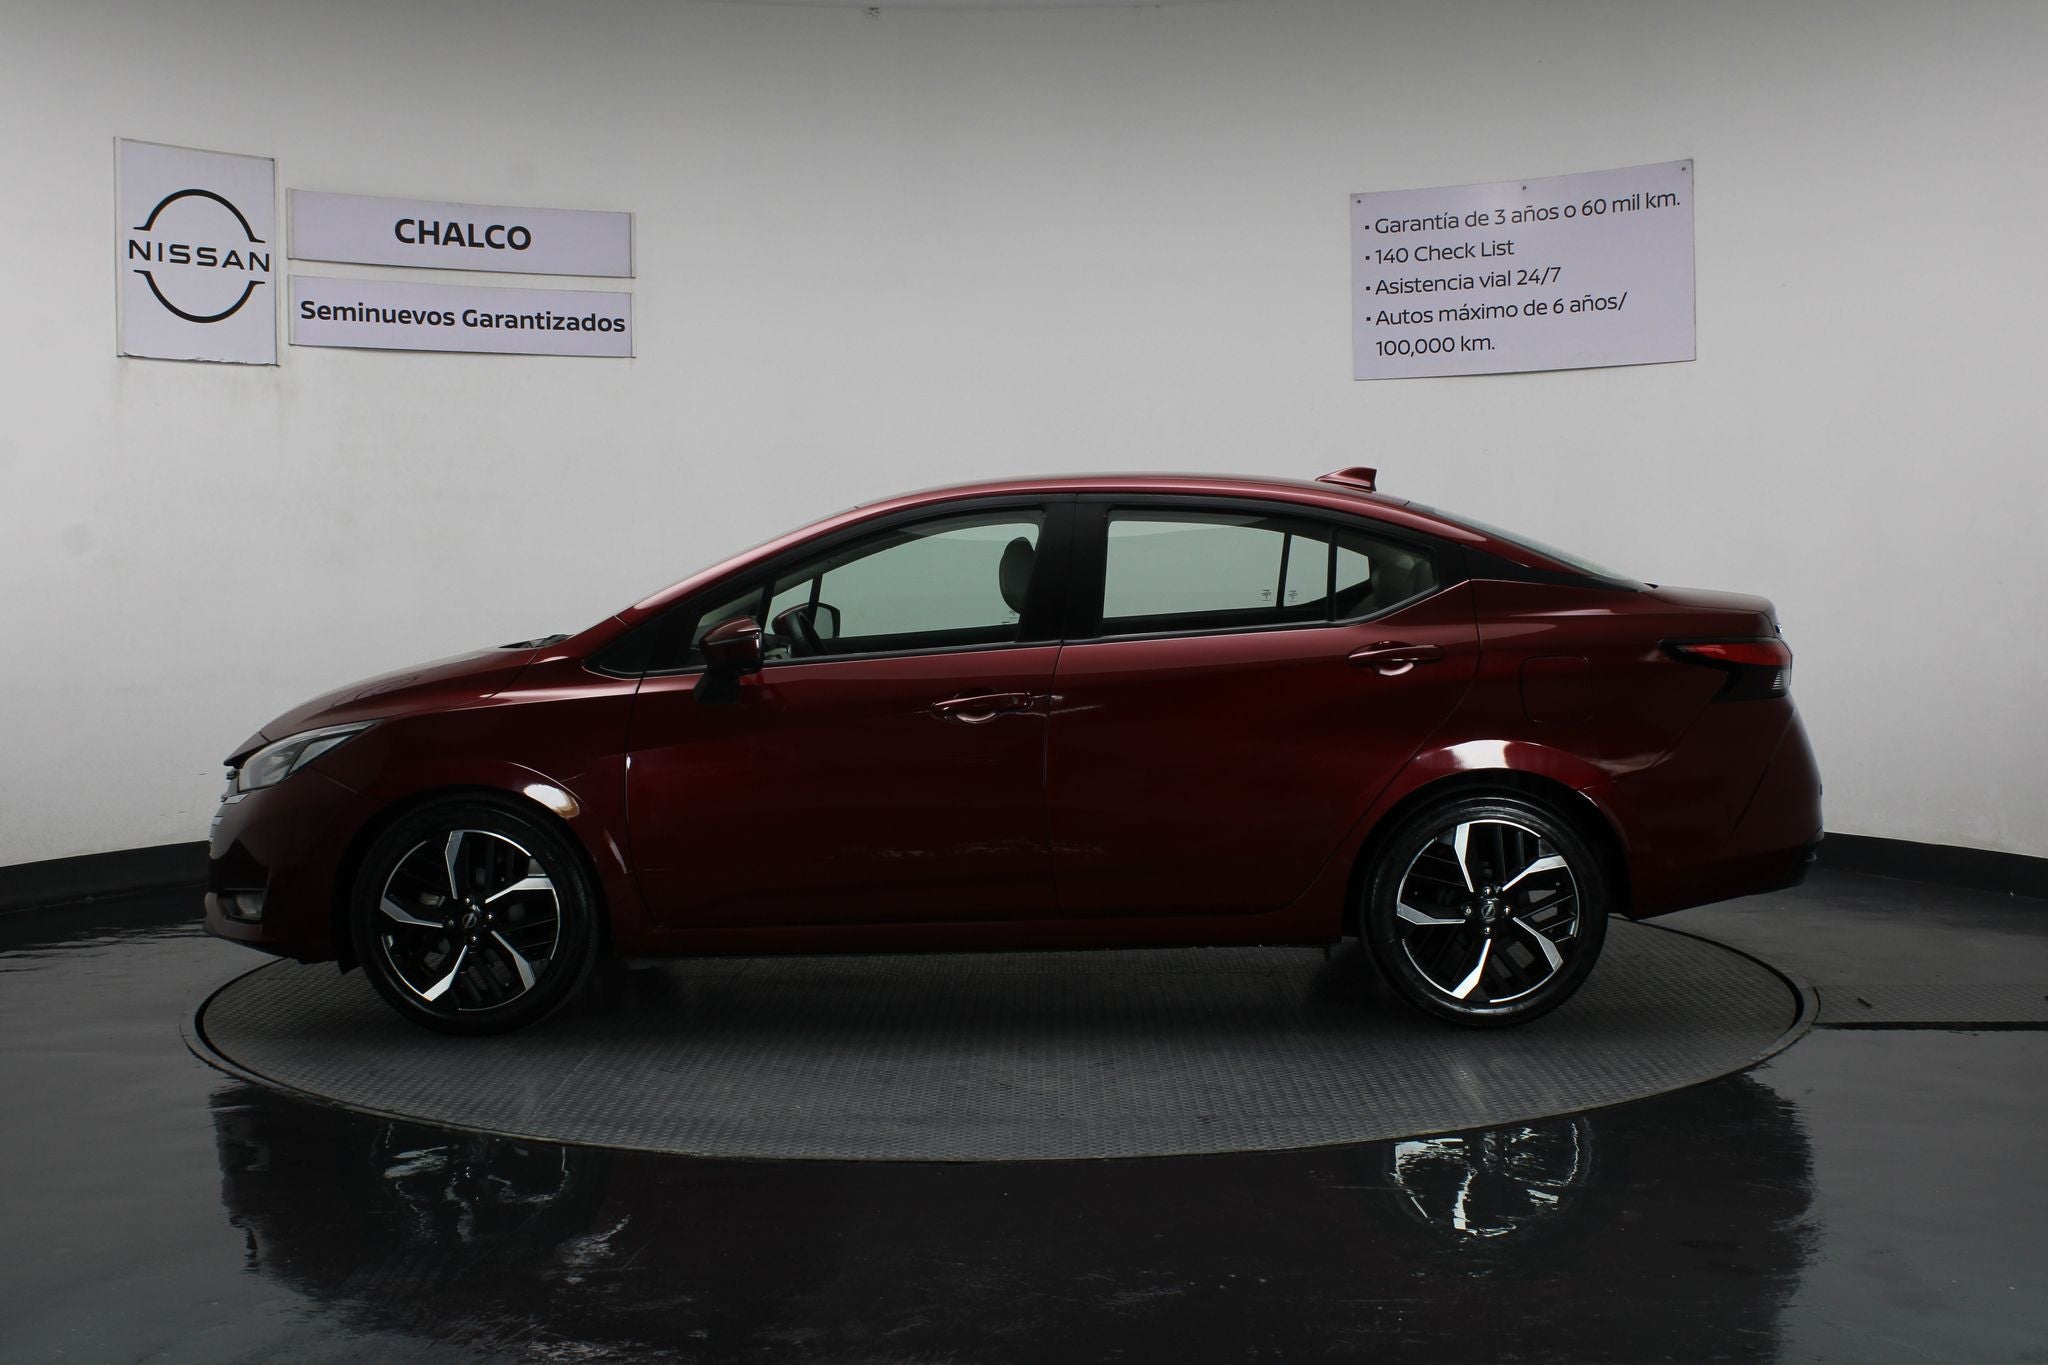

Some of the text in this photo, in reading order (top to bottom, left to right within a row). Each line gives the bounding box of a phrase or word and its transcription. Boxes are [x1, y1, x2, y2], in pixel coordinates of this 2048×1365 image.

[1374, 192, 1681, 234] Garantía de 3 años o 60 mil km.
[394, 218, 532, 251] CHALCO
[128, 237, 270, 274] NISSAN
[1375, 239, 1515, 265] 140 Check List
[1375, 266, 1562, 296] Asistencia vial 24/7
[300, 300, 626, 333] Seminuevos Garantizados
[1375, 291, 1628, 326] Autos máximo de 6 años/
[1375, 335, 1495, 358] 100,000 km.
